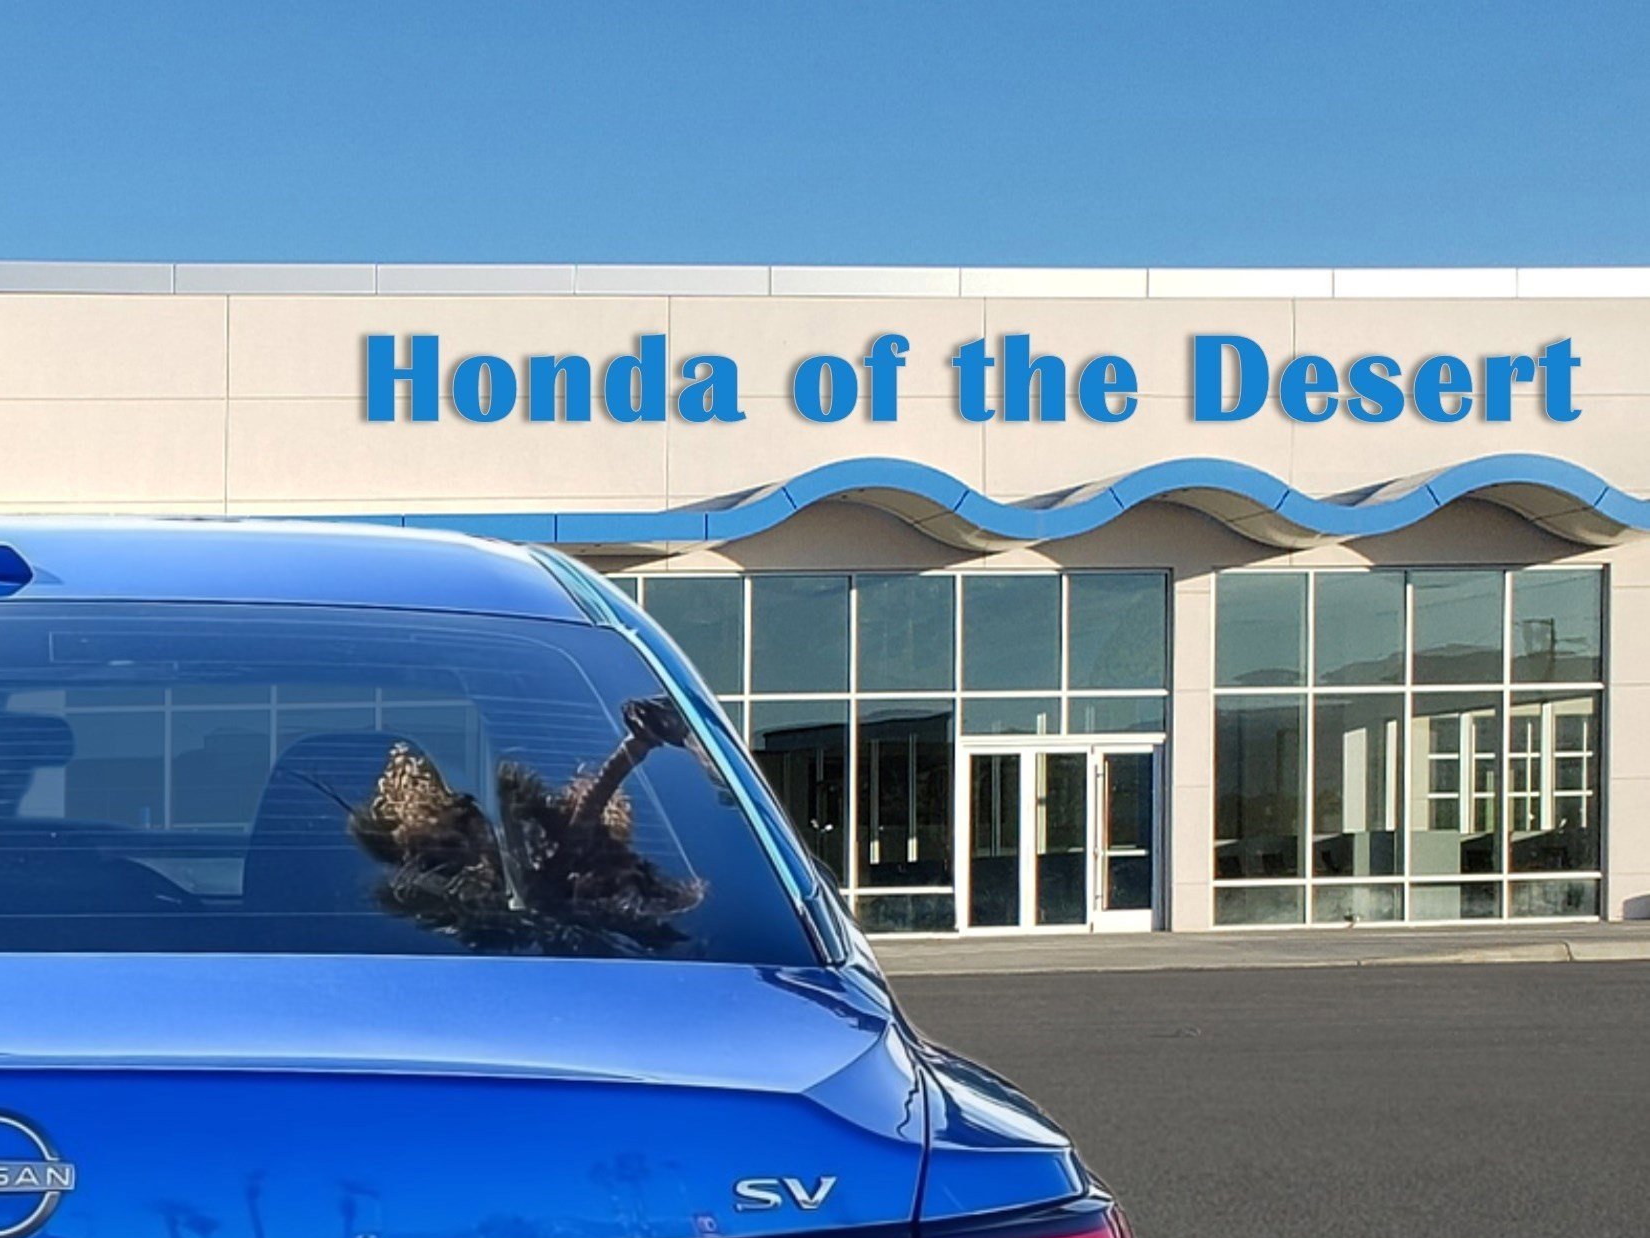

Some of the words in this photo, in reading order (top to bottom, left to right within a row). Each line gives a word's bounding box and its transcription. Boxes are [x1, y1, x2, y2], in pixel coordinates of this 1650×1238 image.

[365, 333, 748, 423] Honda
[793, 333, 911, 423] of
[951, 333, 1139, 423] the
[1193, 334, 1583, 423] Desert
[734, 1175, 838, 1212] SV
